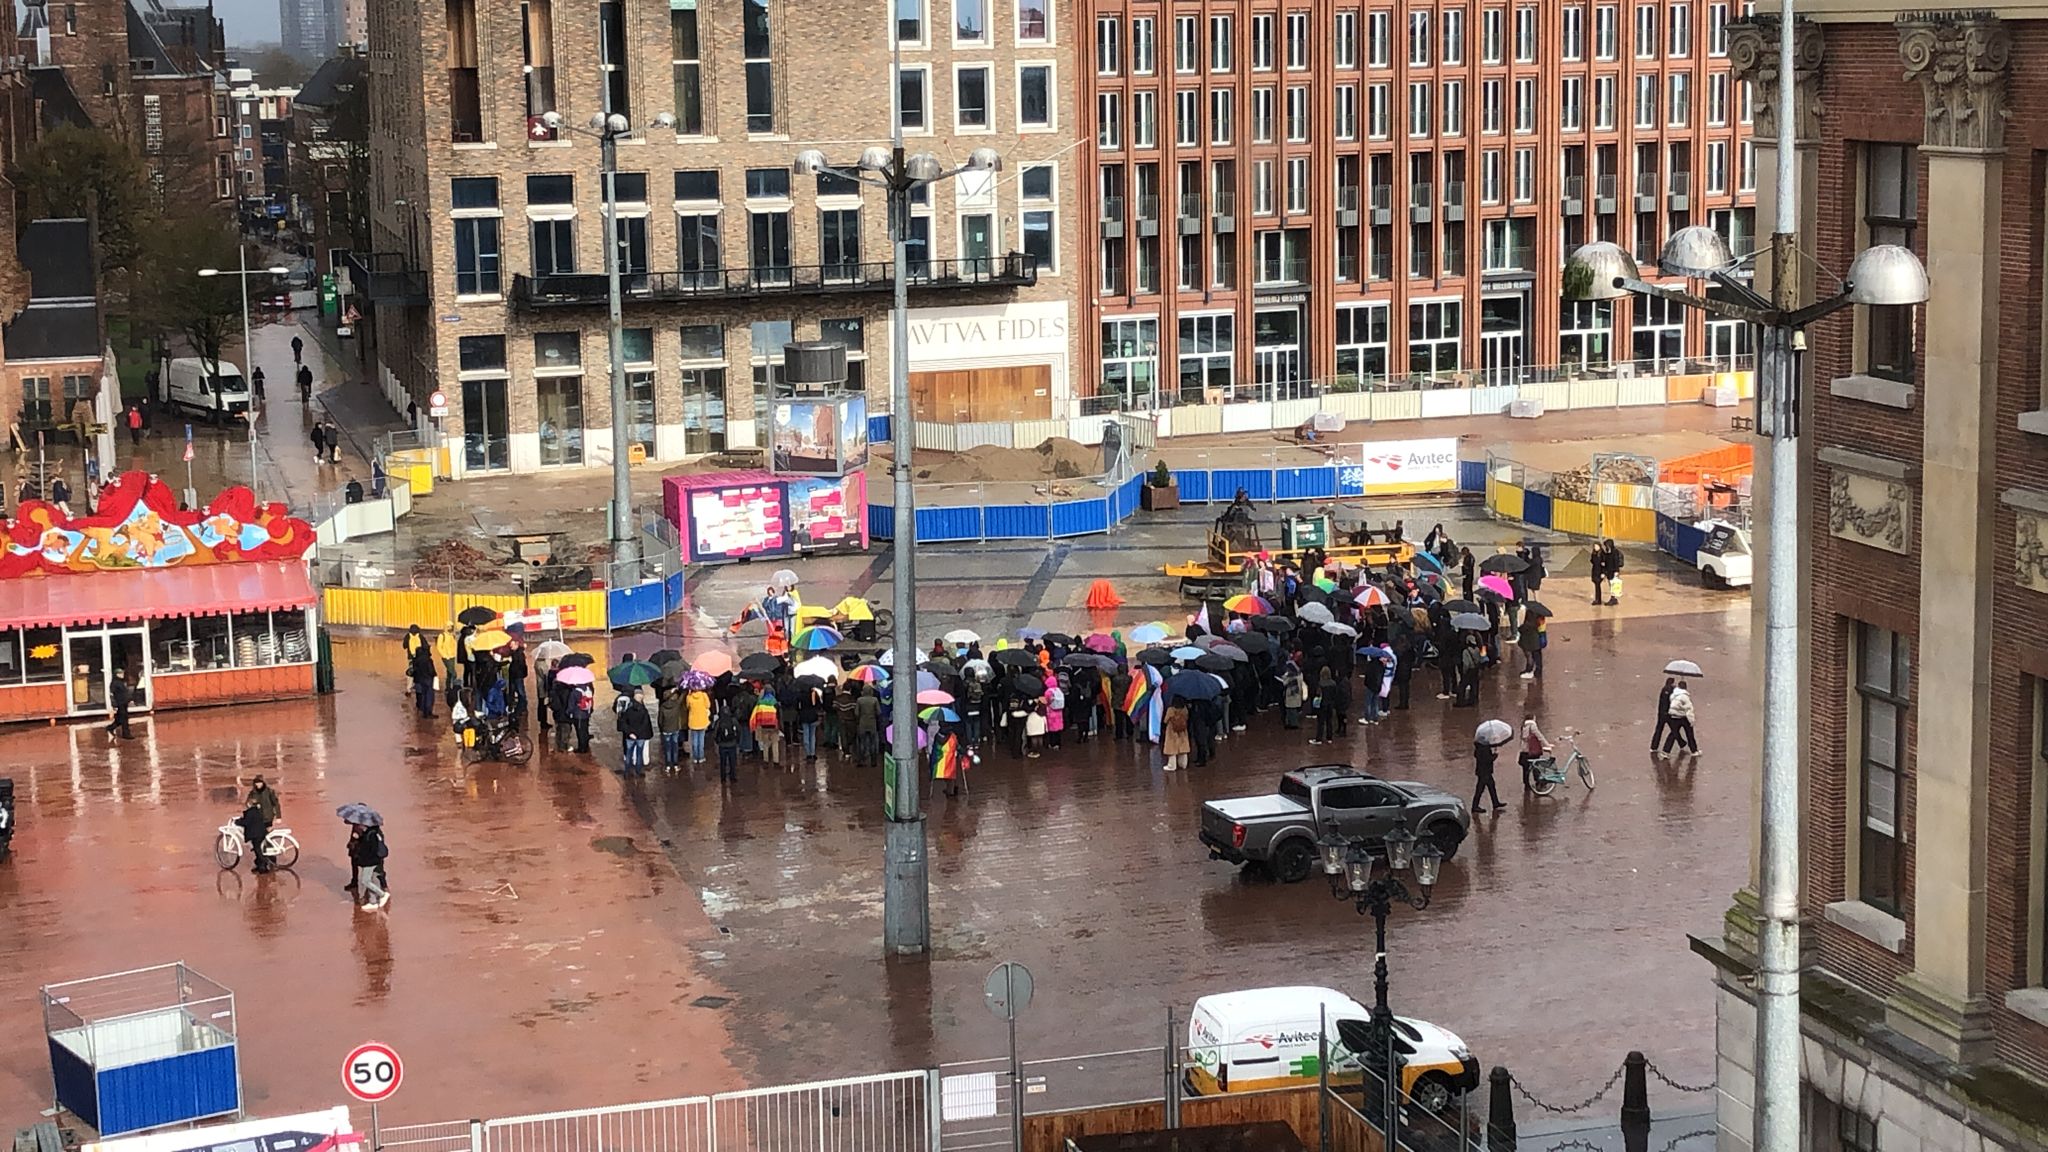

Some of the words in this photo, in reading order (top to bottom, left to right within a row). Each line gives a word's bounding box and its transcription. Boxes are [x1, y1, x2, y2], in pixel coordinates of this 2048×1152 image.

[998, 317, 1065, 341] FIDES
[1407, 453, 1453, 466] Avitec
[1278, 1031, 1318, 1044] Avitec
[354, 1061, 394, 1085] 50
